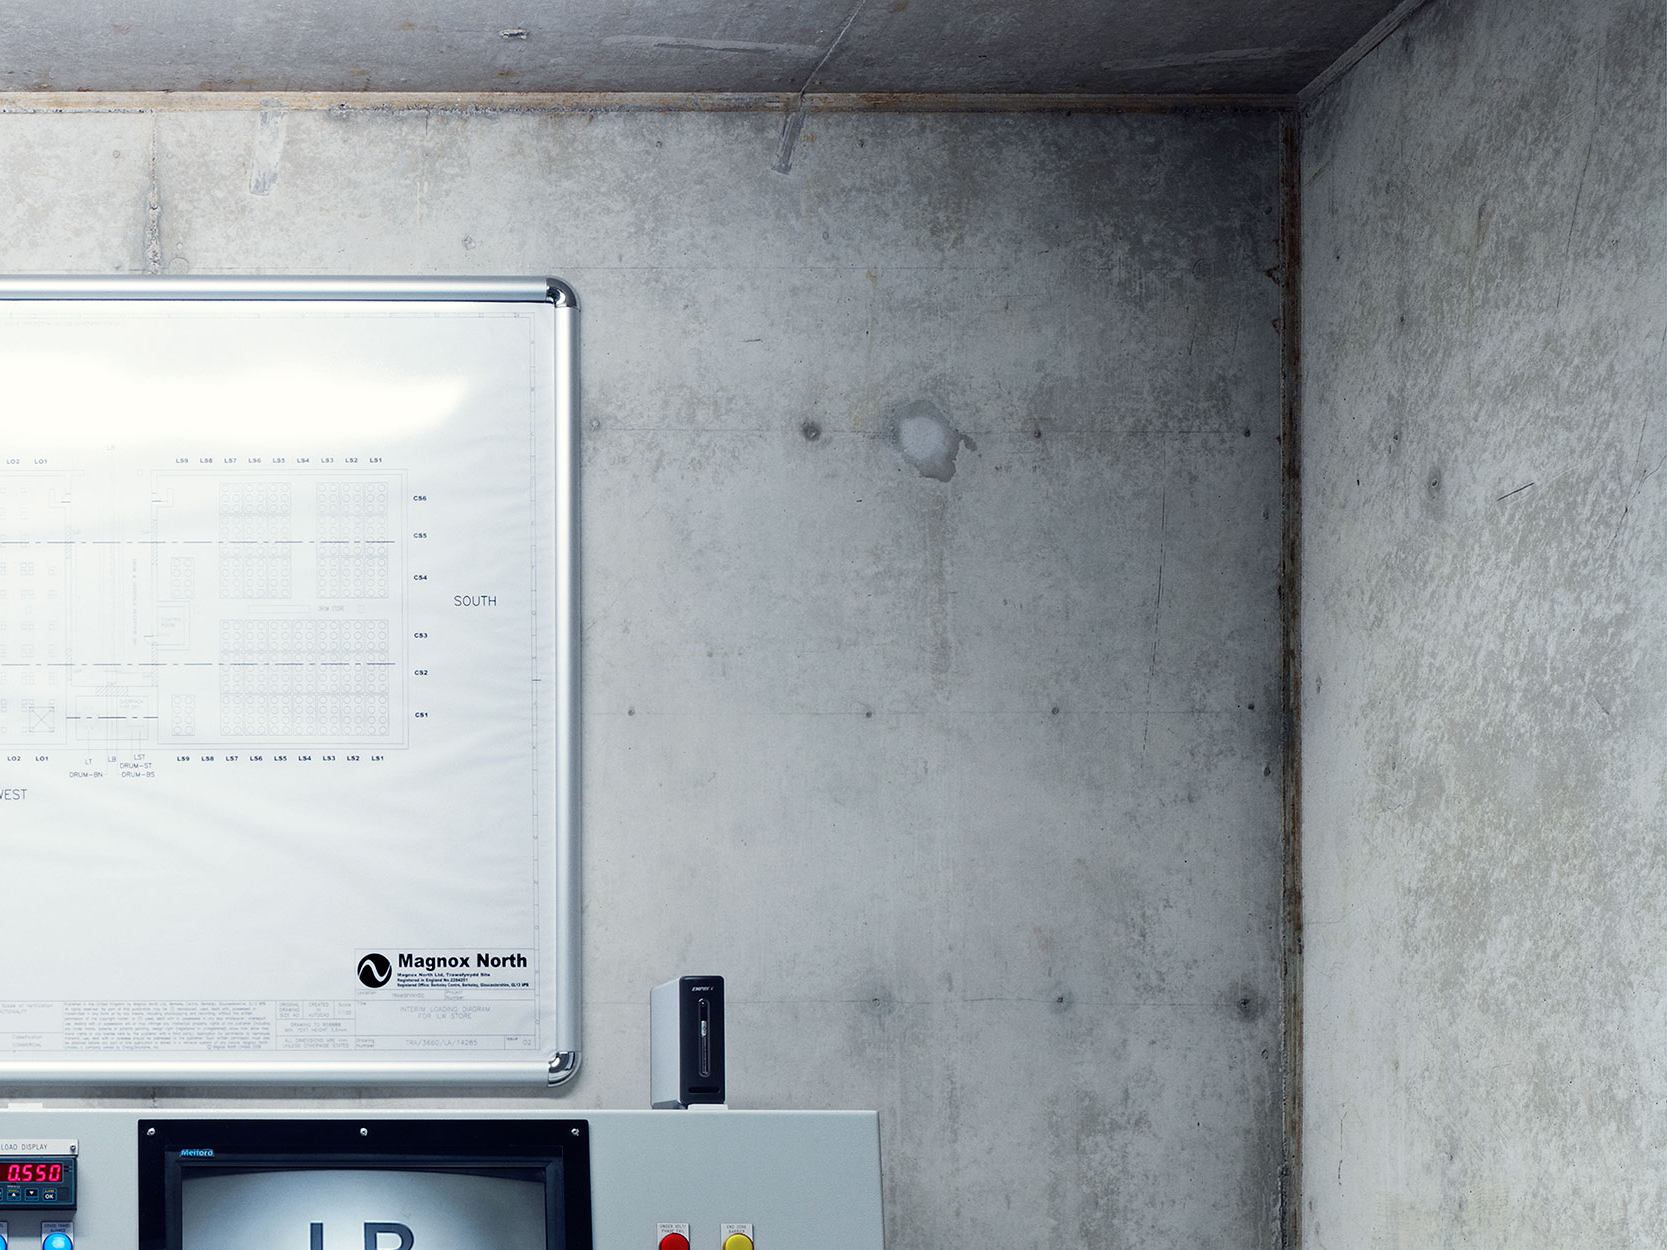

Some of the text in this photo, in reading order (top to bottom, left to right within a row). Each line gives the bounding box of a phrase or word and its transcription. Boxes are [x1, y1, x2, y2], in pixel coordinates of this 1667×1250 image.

[453, 594, 498, 608] SOUTH
[398, 953, 527, 971] Magnox North
